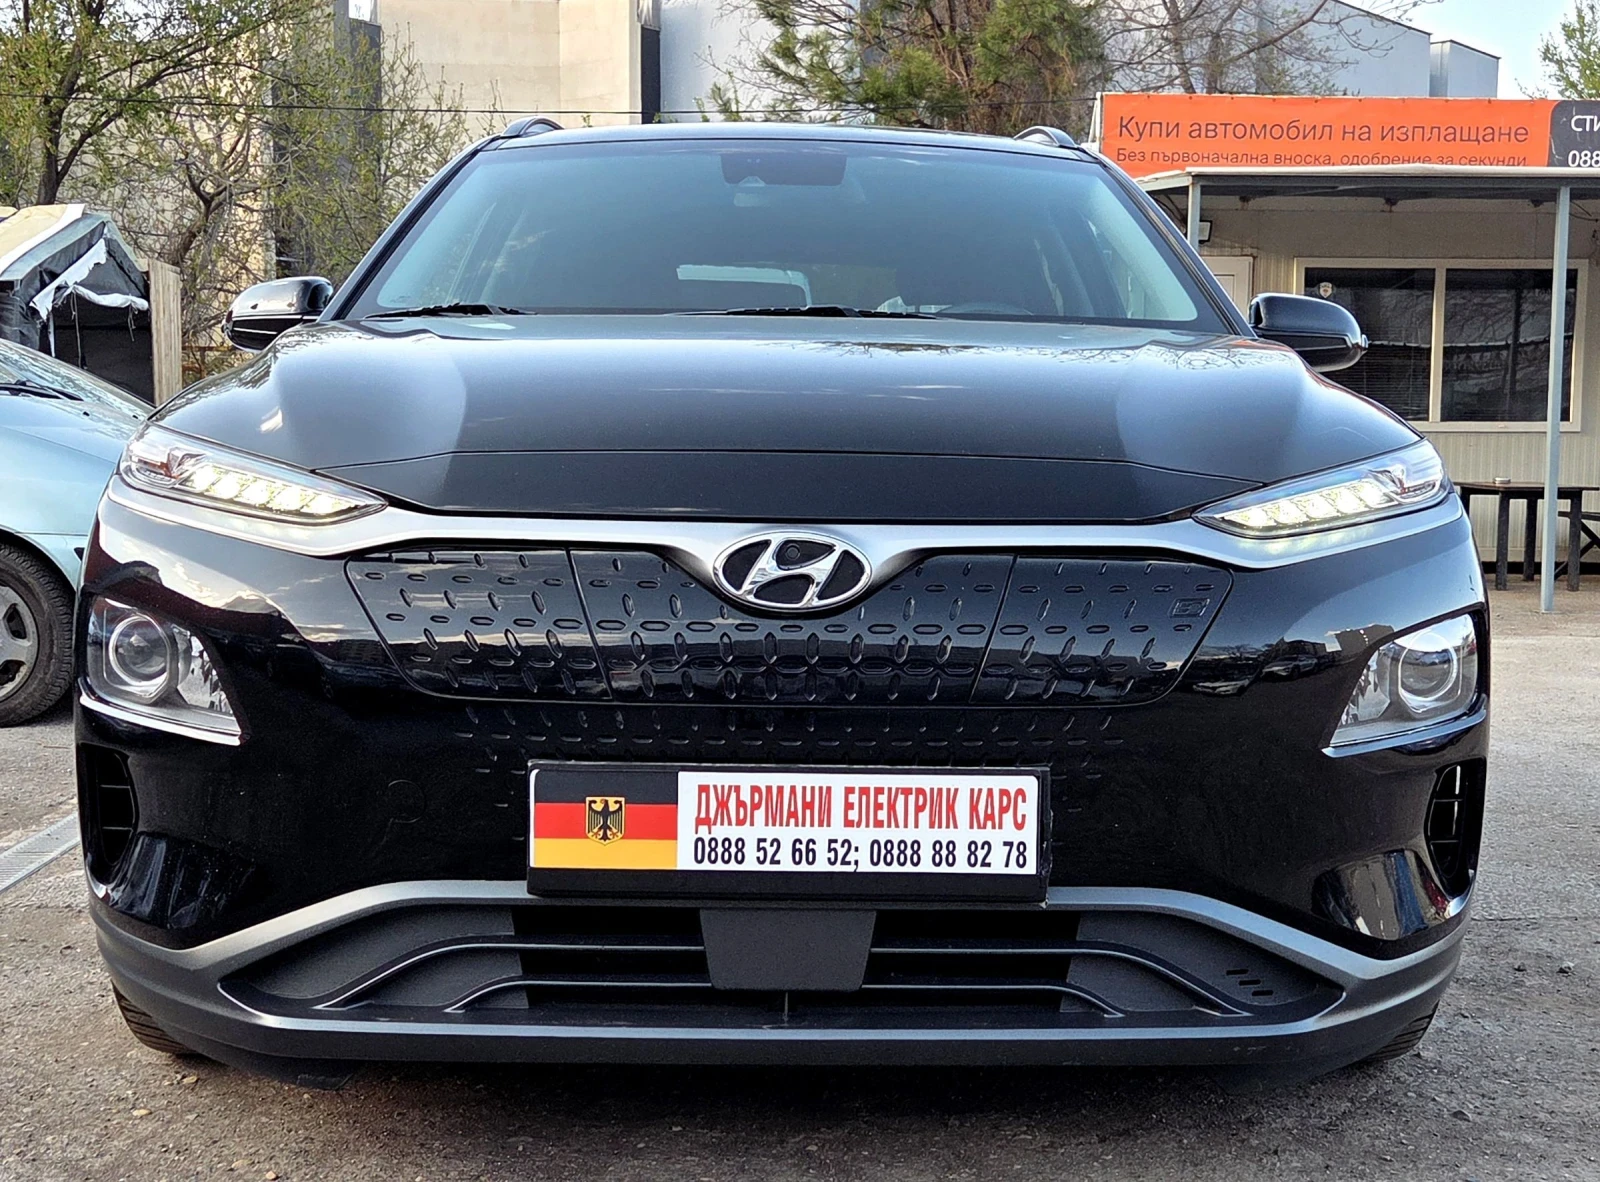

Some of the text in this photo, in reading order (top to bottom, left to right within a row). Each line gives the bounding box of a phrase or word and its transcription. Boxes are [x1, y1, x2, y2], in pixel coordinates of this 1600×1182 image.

[1118, 116, 1529, 145] Купи автомобил на изплащане
[1116, 148, 1146, 162] Без
[1150, 151, 1269, 164] първоначална
[1273, 153, 1336, 166] вноска,
[1340, 152, 1432, 166] одобрение
[1436, 155, 1454, 165] за
[695, 784, 1027, 835] ДЖЪРМАНИ ЕЛЕКТРИК КАРС
[694, 837, 1027, 872] 0888 52 66 52; 0888 88 82 78
